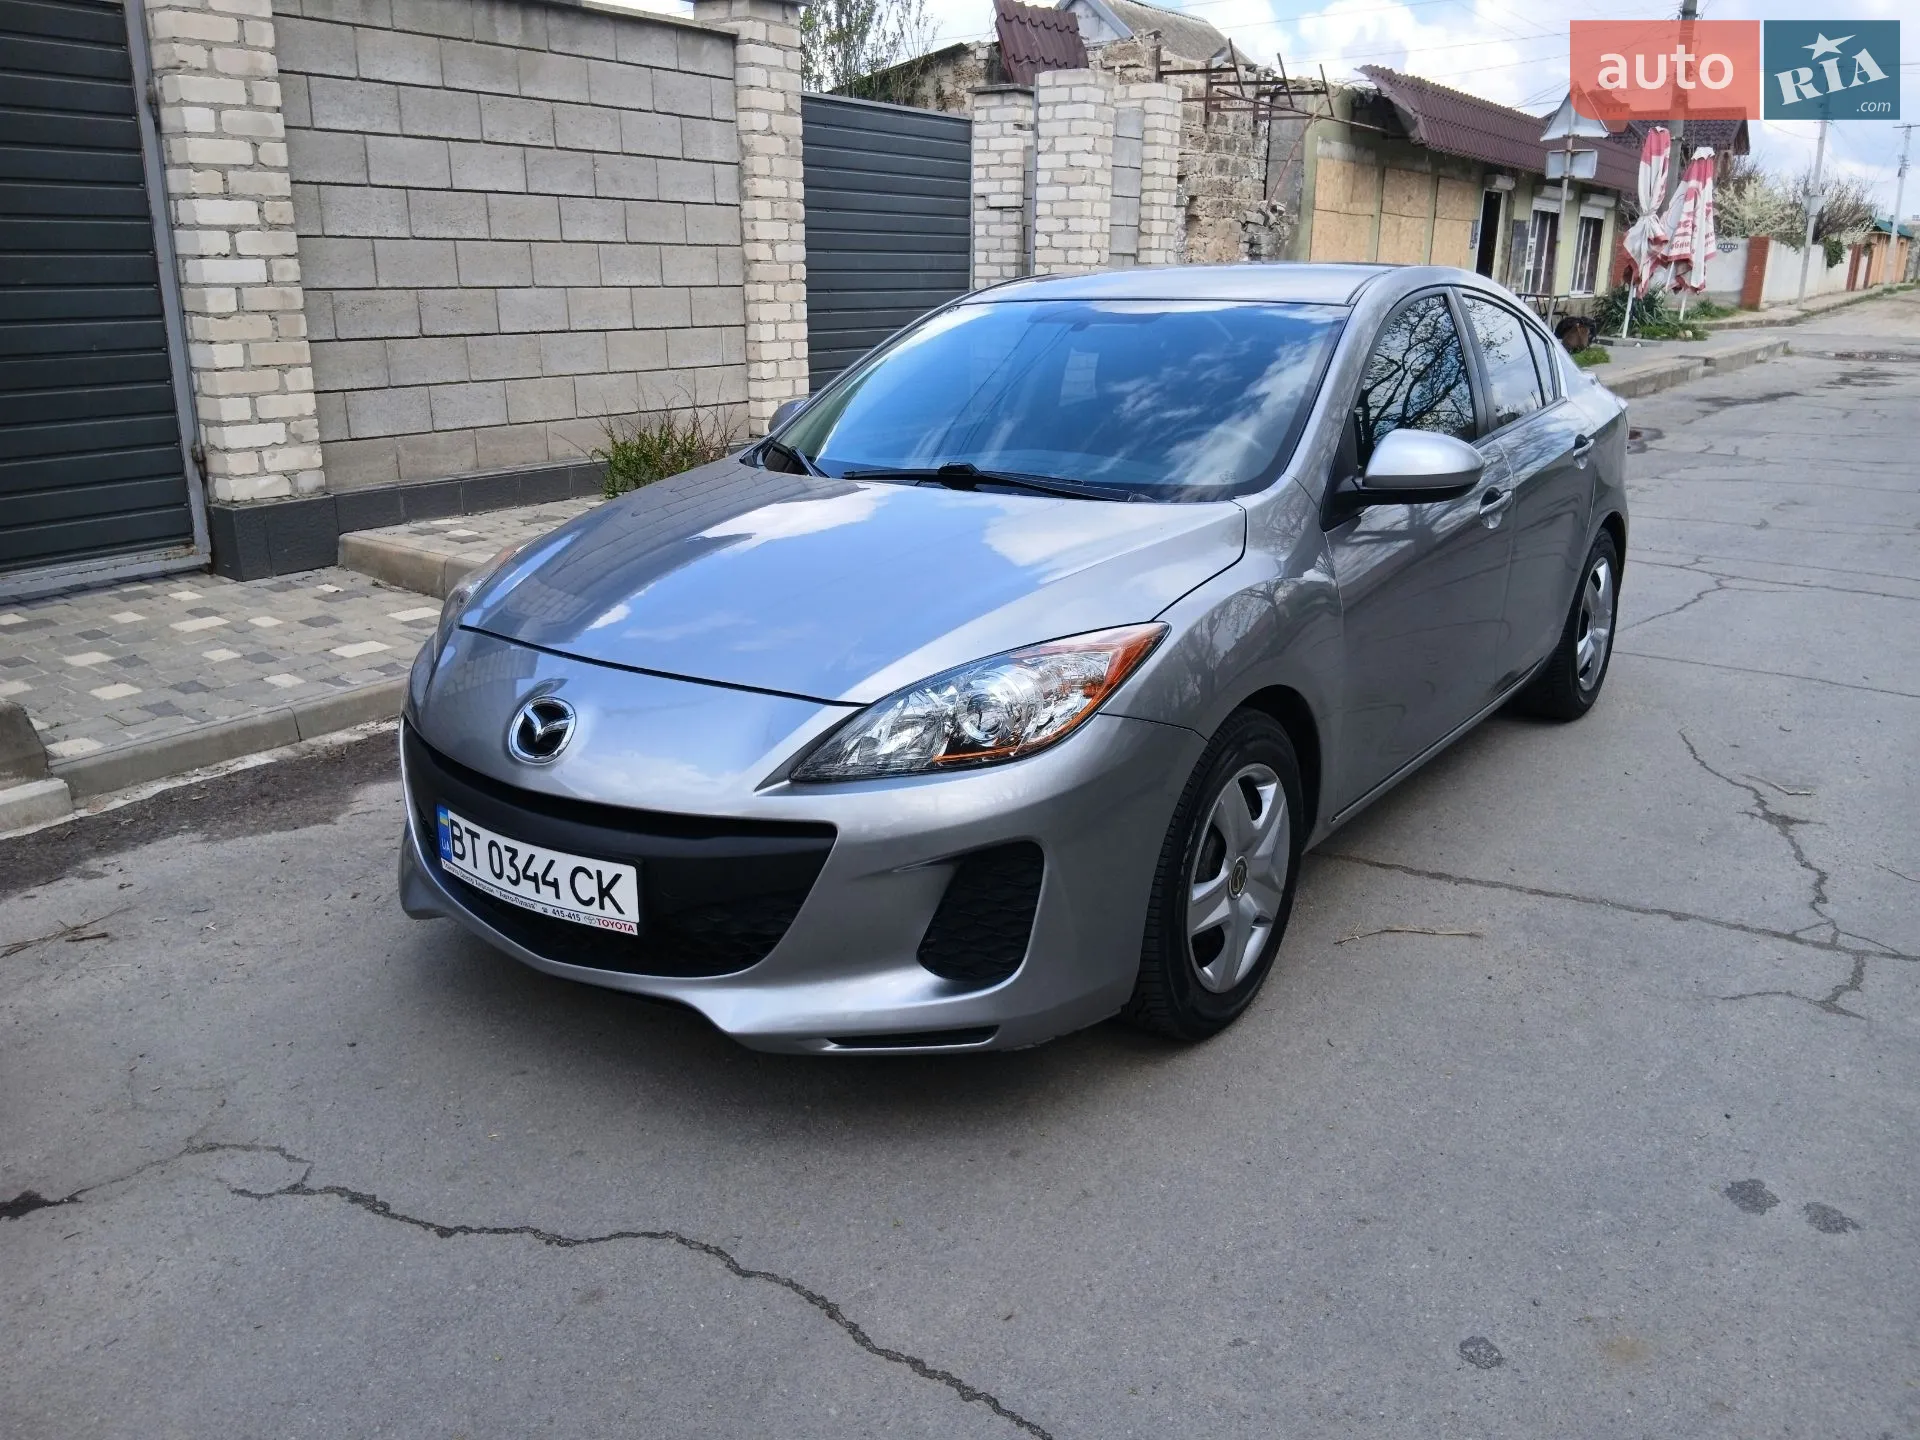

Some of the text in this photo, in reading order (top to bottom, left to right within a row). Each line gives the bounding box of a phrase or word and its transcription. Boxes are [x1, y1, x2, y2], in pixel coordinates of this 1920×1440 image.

[441, 838, 451, 854] UA
[449, 818, 625, 915] BT 0344 CK
[551, 908, 582, 922] 415-415
[596, 917, 635, 933] TOYOTA
